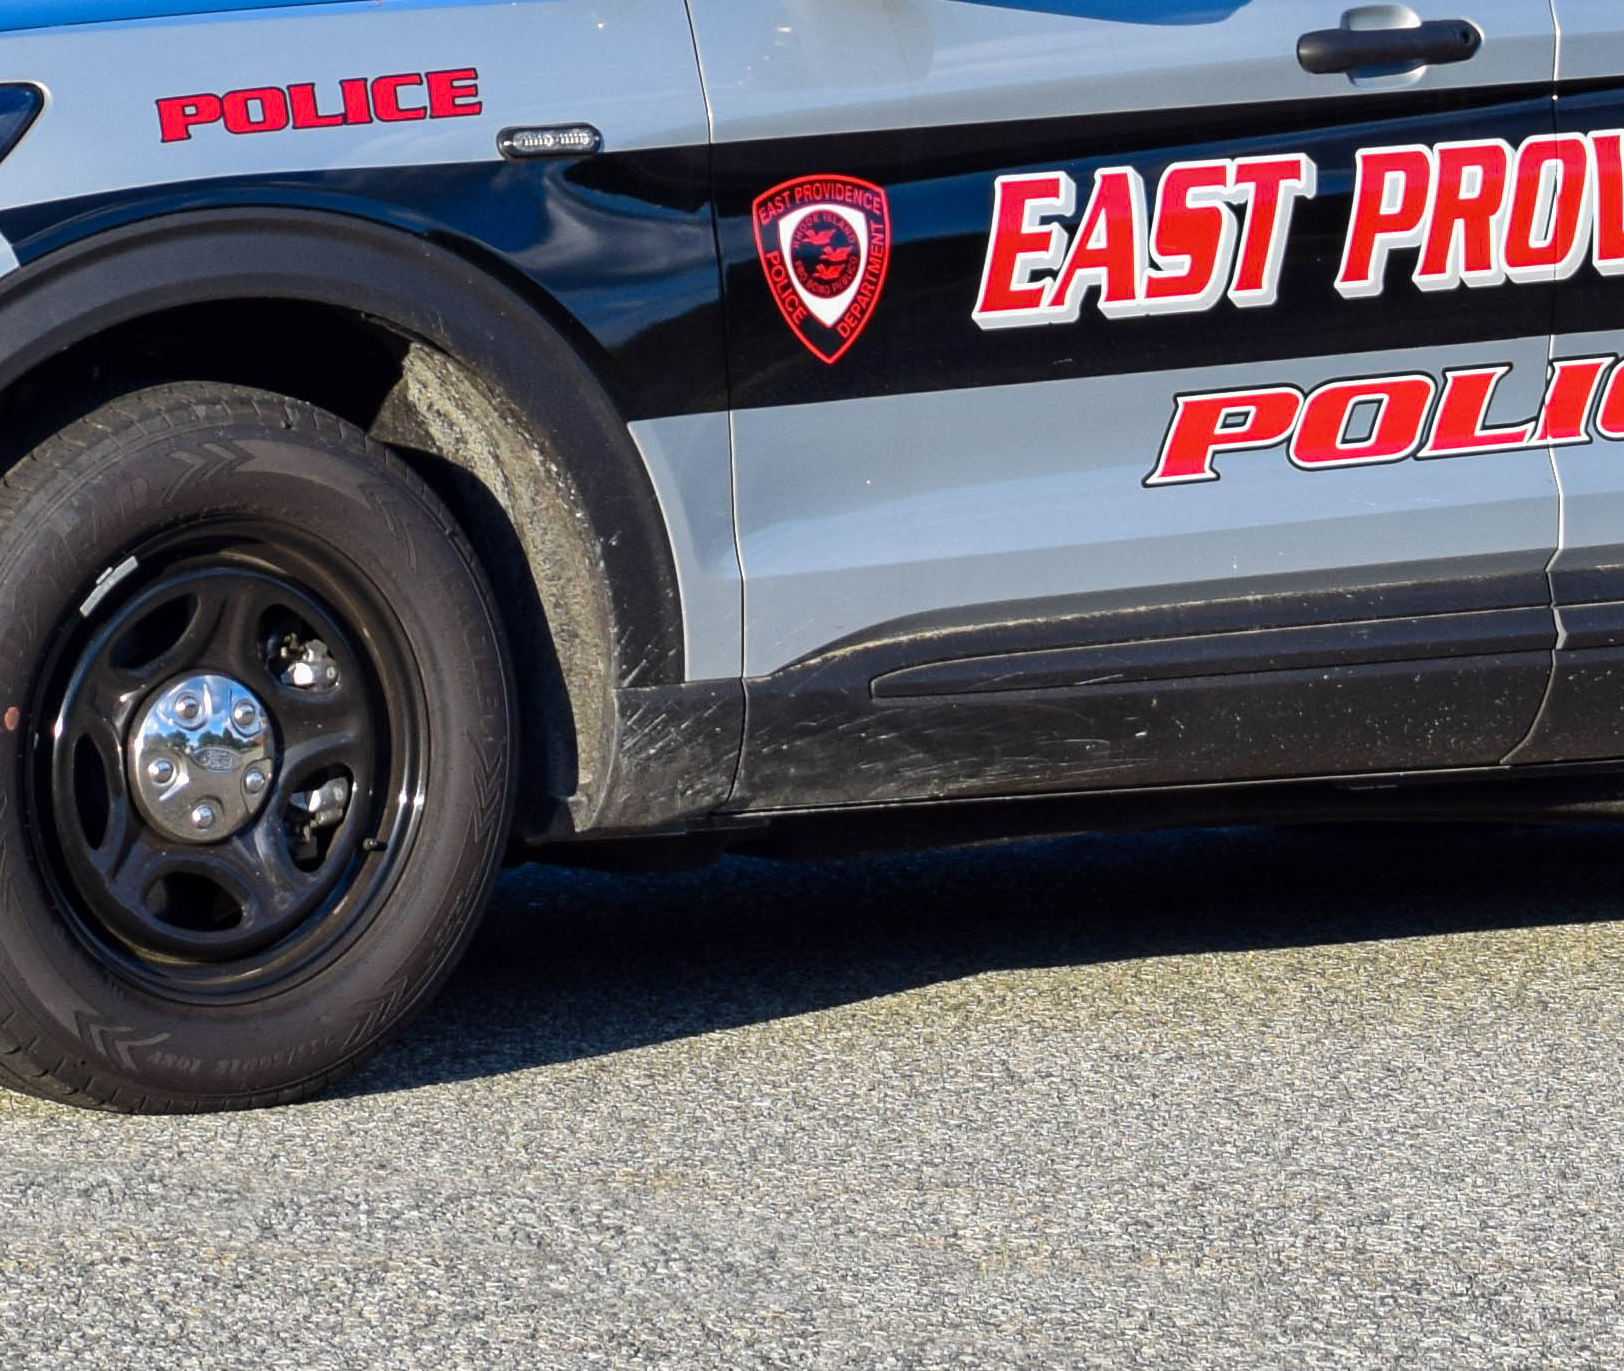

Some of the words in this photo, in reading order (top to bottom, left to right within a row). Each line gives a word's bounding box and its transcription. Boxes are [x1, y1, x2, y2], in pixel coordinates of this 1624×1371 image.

[155, 67, 483, 143] POLICE
[759, 191, 791, 225] EAST
[794, 182, 883, 216] PROVIDENCE
[836, 220, 885, 339] DEPARTMENT
[970, 152, 1317, 333] EAST
[765, 251, 808, 326] POLICE
